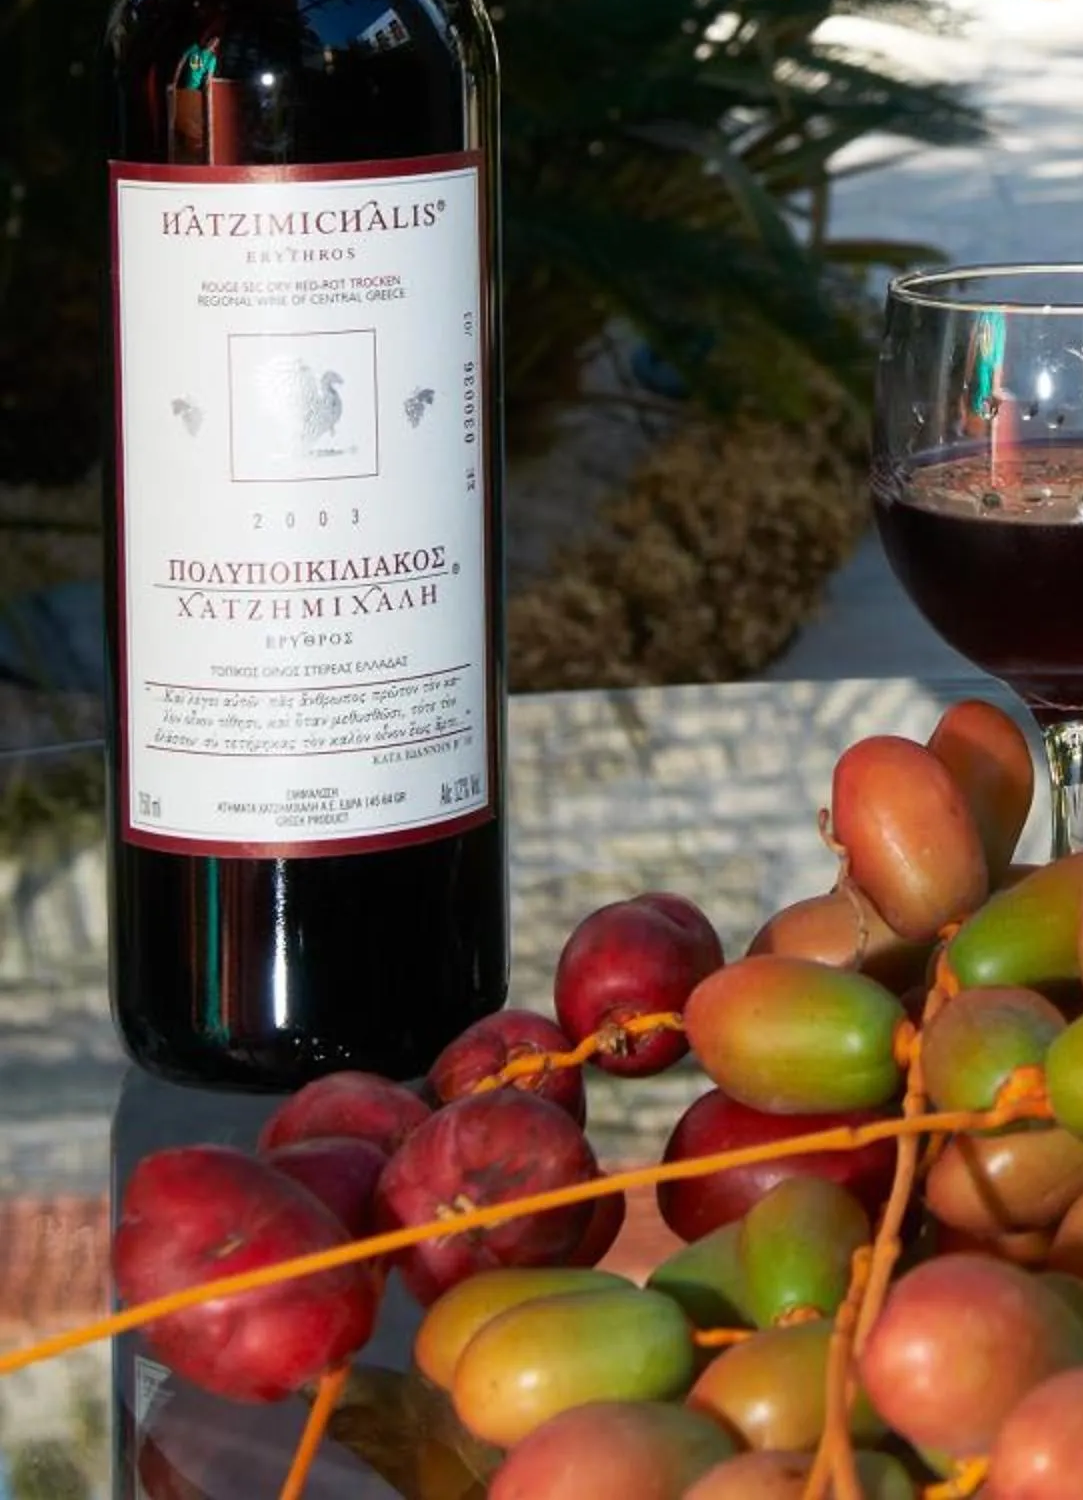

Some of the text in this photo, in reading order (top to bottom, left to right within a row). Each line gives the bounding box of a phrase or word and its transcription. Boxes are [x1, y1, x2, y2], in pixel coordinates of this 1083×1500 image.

[246, 247, 356, 264] ERYTHROS
[201, 280, 239, 294] ROUGE
[350, 274, 401, 290] TROCKEN
[198, 288, 406, 308] REGIONAL WINE OF CENTRAL GREECE
[355, 655, 408, 673] ΕΛΛΑΔΑΣ
[307, 811, 350, 826] PRODUCT
